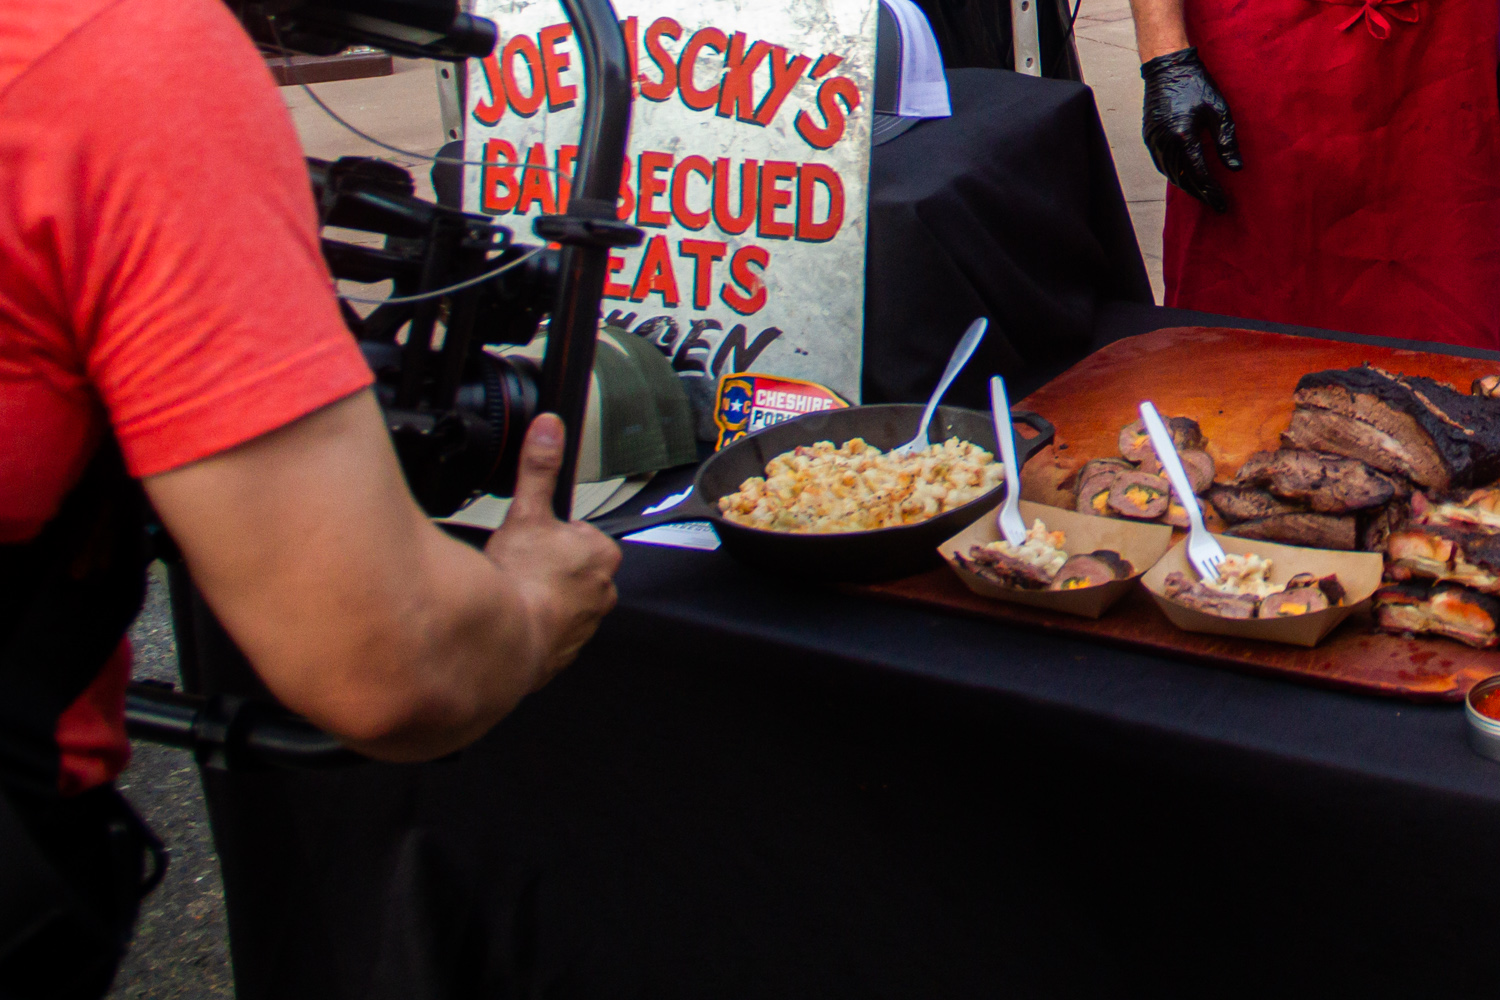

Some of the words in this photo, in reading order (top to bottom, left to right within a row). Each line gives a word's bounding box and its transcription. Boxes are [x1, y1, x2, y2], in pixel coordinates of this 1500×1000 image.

[473, 22, 577, 127] JOE
[622, 16, 861, 149] ISCKY'S
[603, 234, 771, 316] EATS
[755, 388, 833, 412] CHESHIRE
